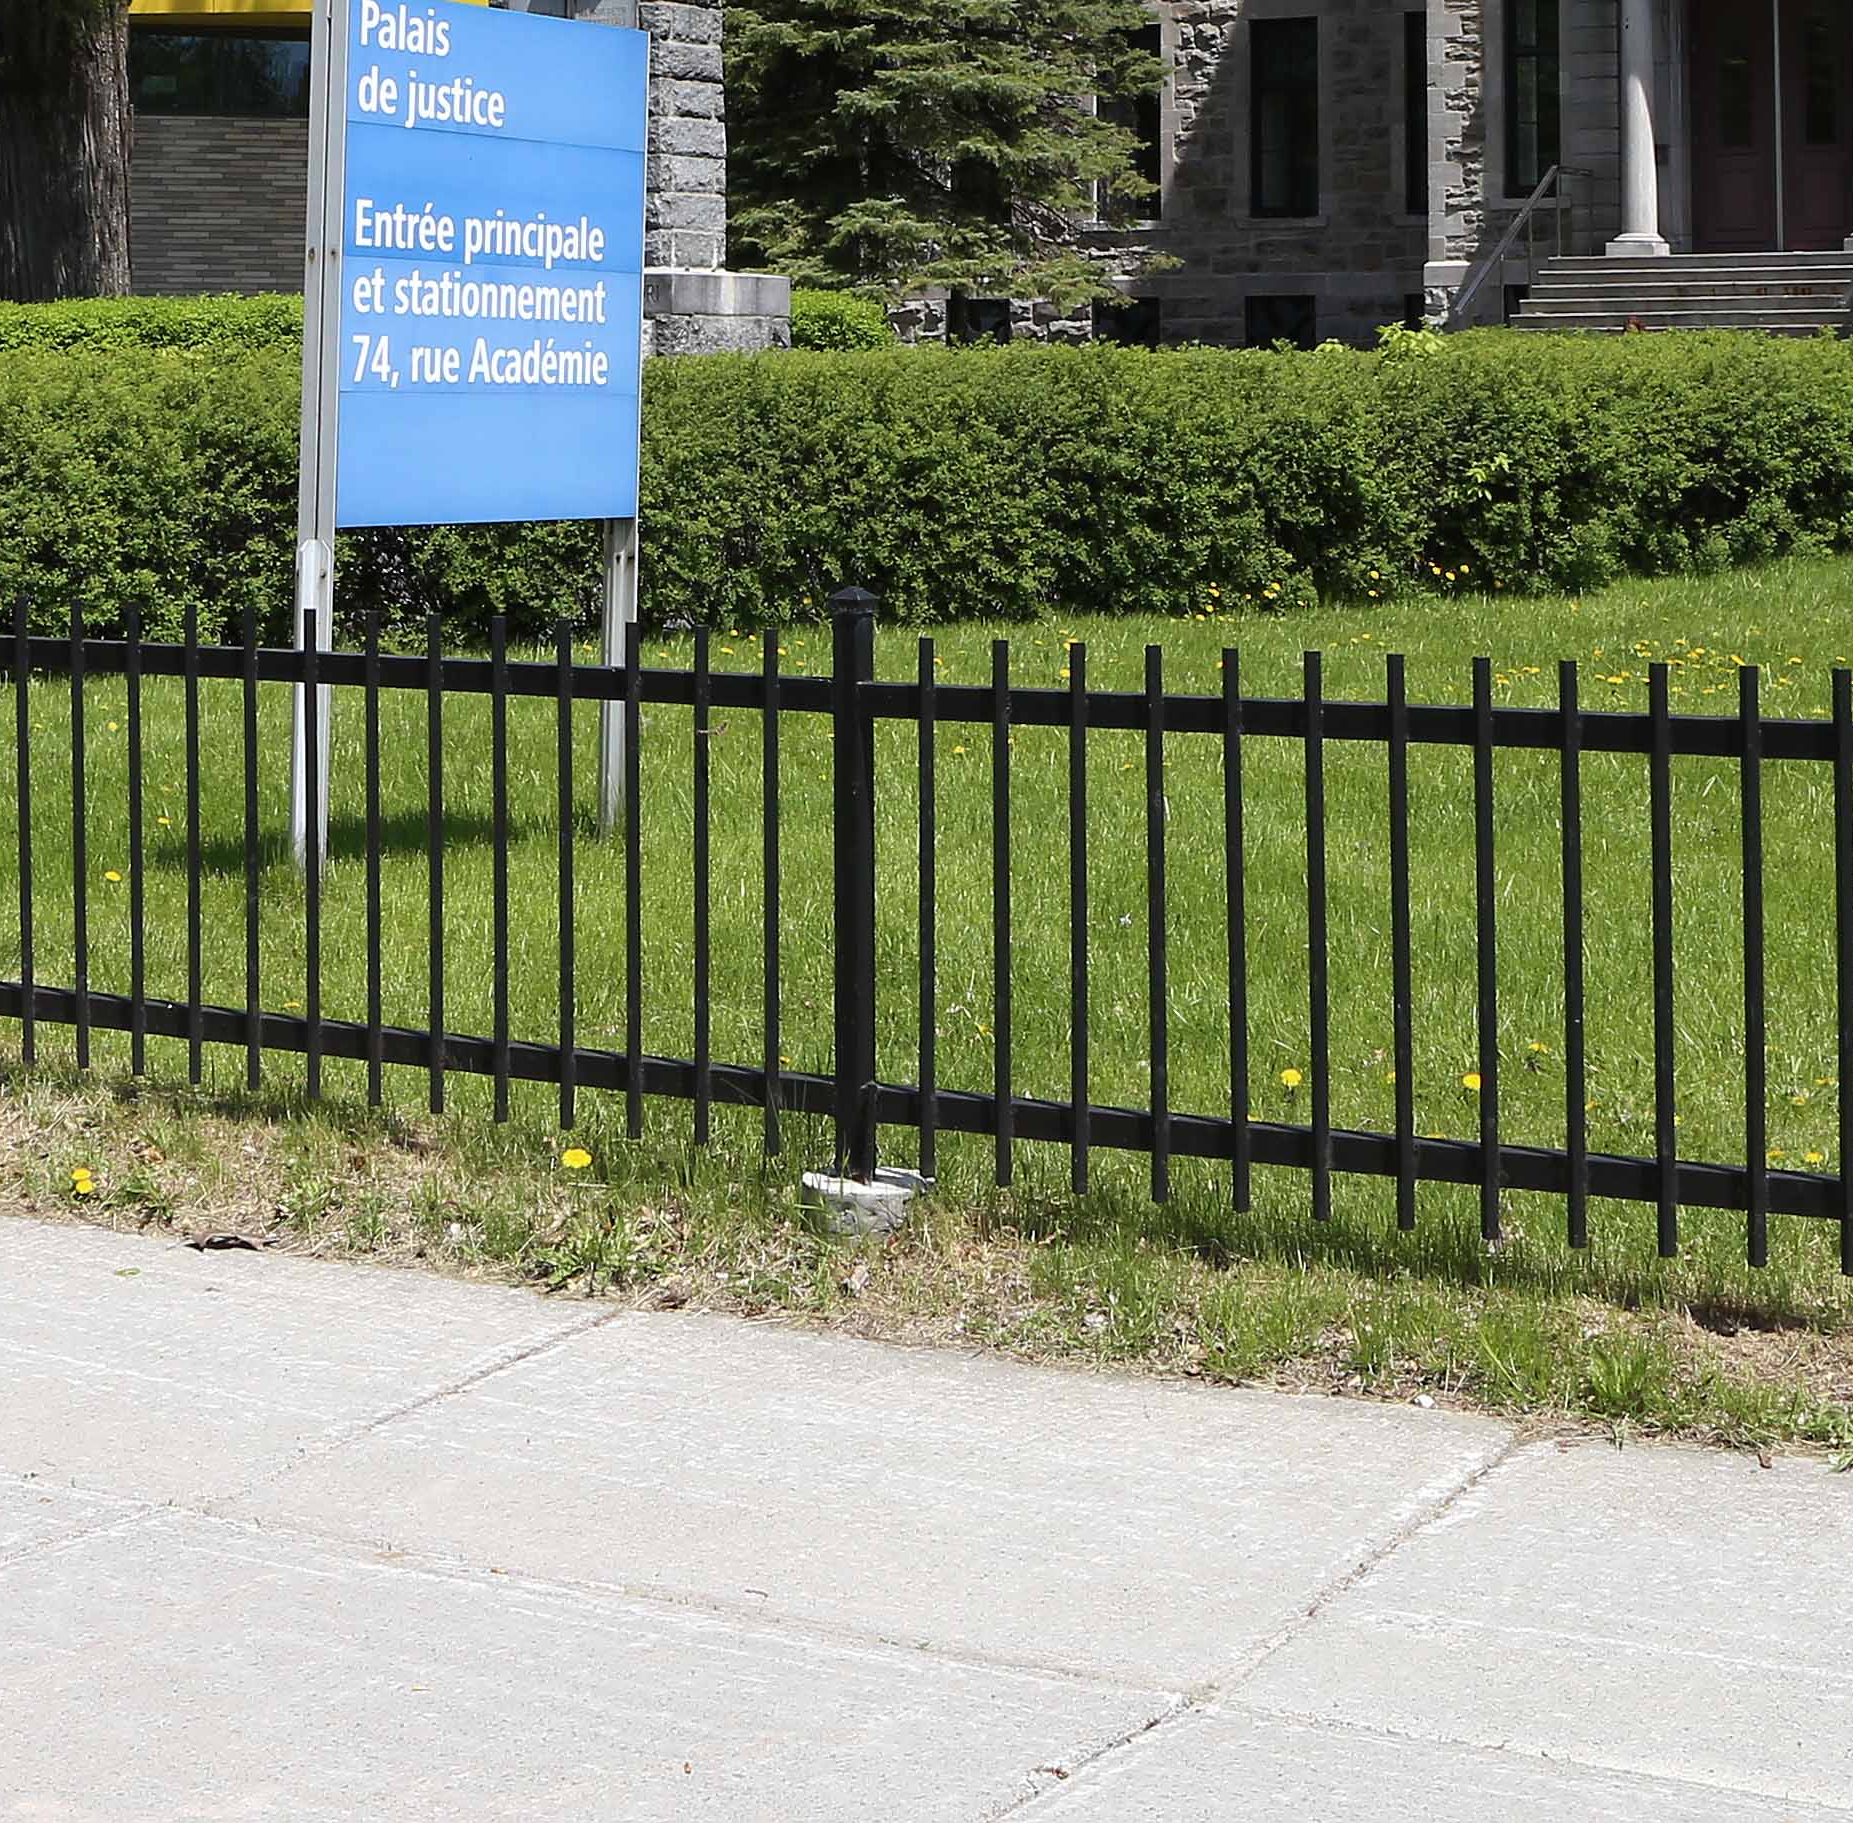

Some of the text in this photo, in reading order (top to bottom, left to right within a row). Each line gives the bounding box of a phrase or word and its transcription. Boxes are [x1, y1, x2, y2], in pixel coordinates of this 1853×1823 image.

[360, 0, 450, 56] Palais
[358, 65, 505, 128] de justice
[355, 198, 604, 269] Entrée principale
[352, 267, 606, 324] et stationnement
[352, 335, 608, 388] 74, rue Académie
